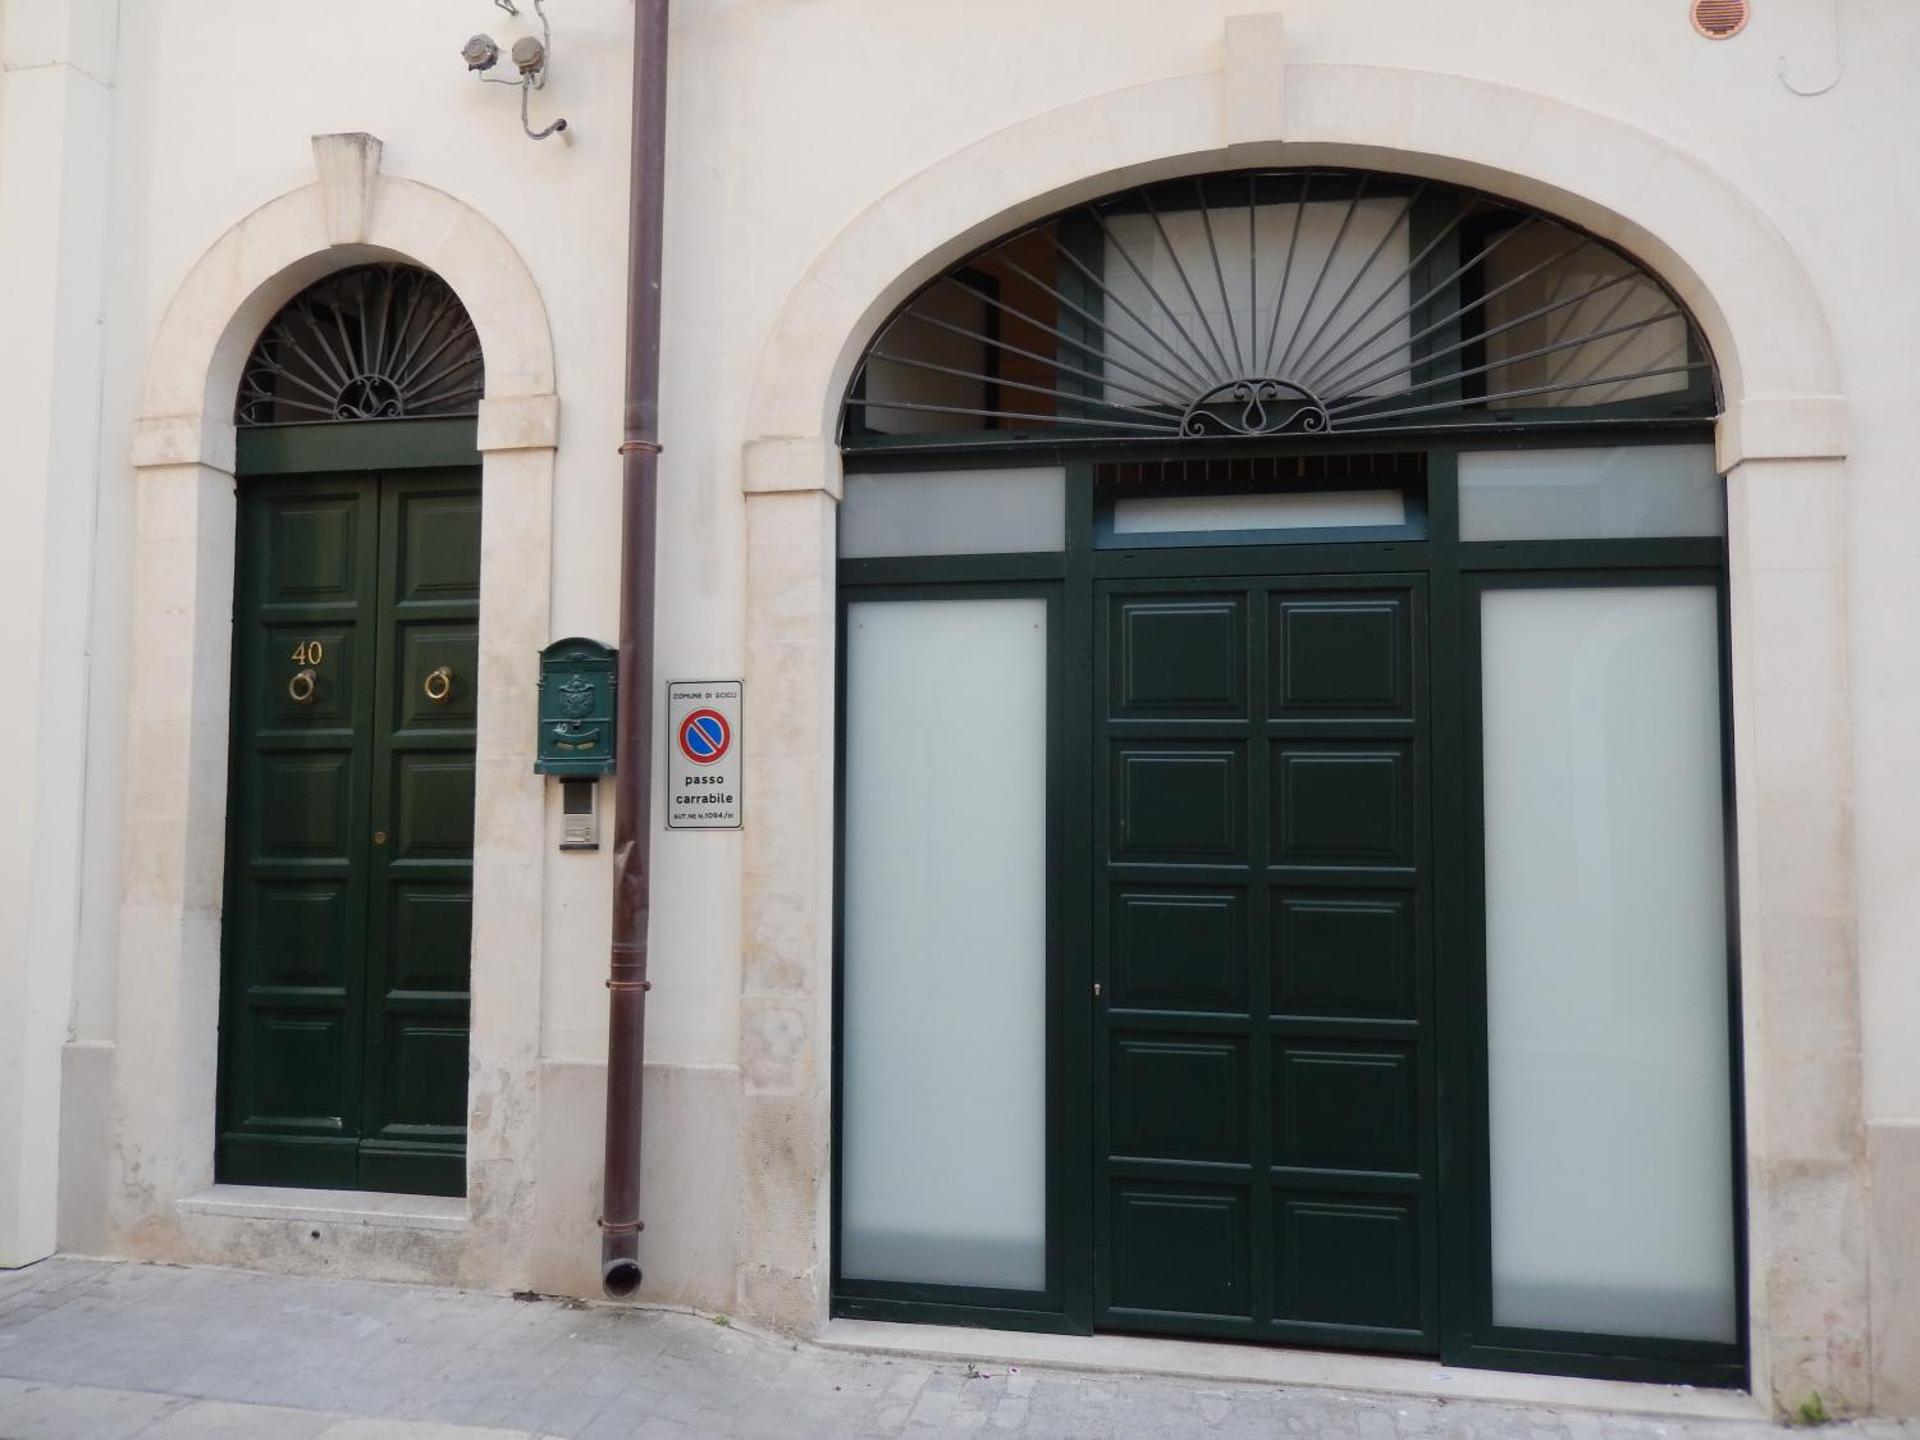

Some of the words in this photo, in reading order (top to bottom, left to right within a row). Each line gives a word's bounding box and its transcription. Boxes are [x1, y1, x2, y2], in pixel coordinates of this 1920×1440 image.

[291, 641, 322, 665] 40
[673, 692, 702, 700] COMUNE
[685, 776, 724, 787] passo
[676, 793, 733, 804] carrabile
